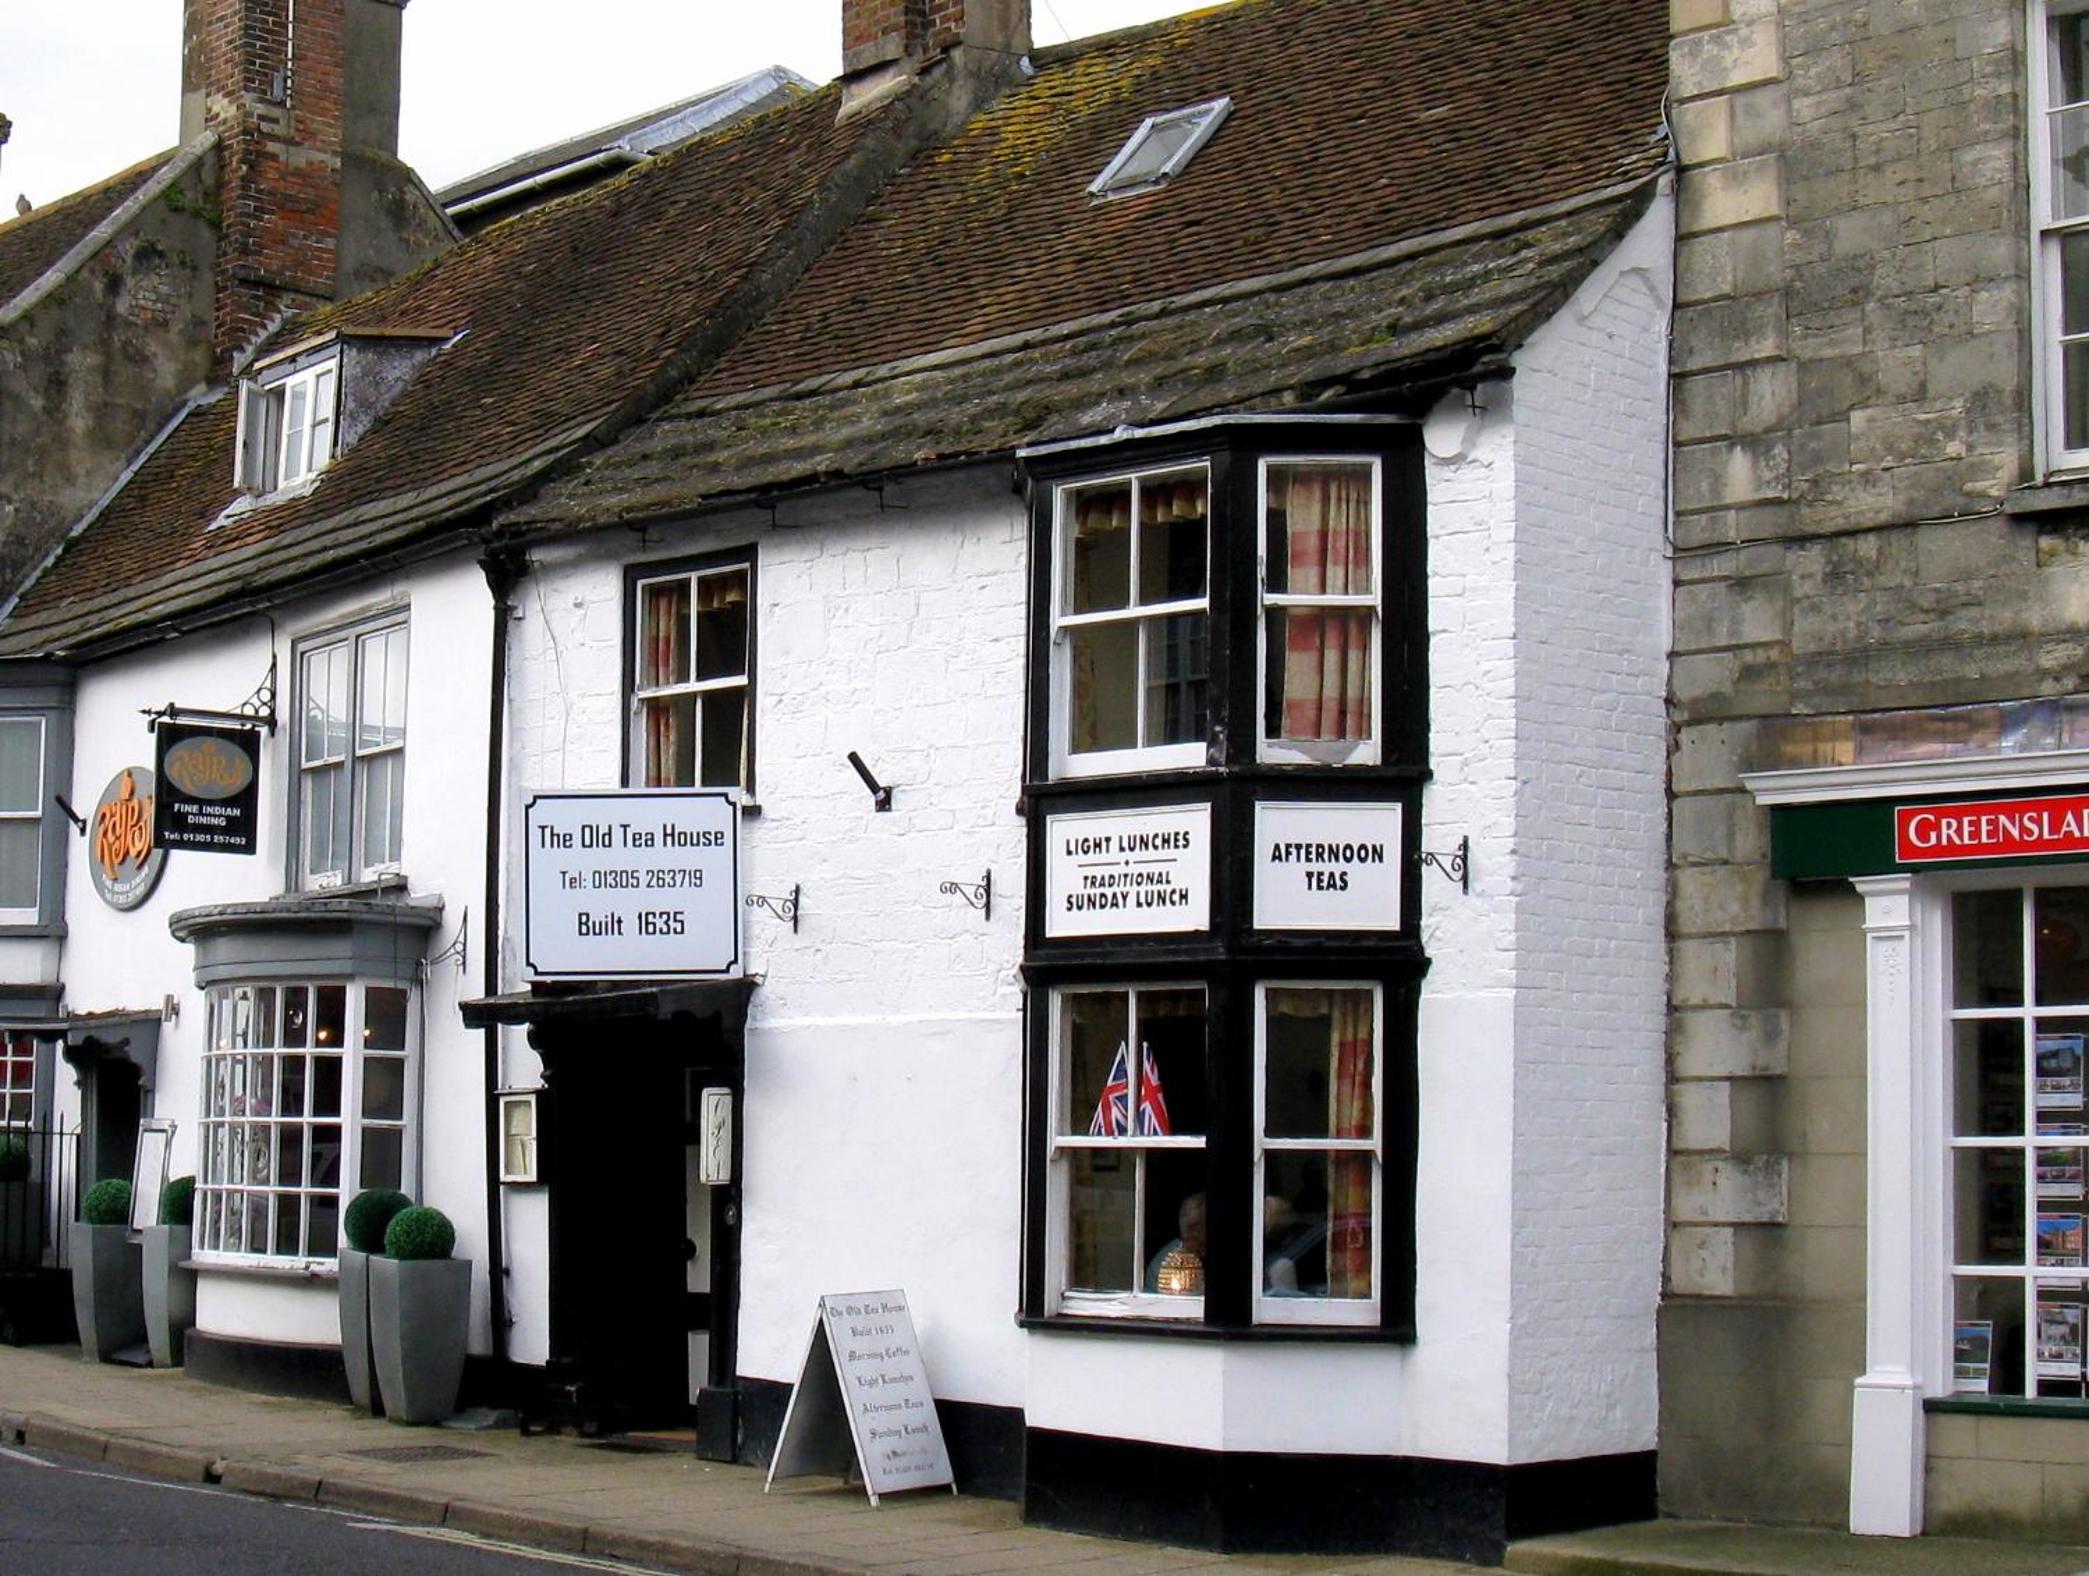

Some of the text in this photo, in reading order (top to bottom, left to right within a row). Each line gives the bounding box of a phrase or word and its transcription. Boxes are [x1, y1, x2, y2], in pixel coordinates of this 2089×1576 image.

[174, 802, 241, 817] FINE INDIAN
[187, 814, 227, 826] DINING
[1908, 809, 2089, 848] GREENSLA
[183, 833, 211, 843] 01305
[538, 823, 725, 849] The Old Tea House
[1065, 830, 1190, 857] LIGHT LUNCHES
[1271, 842, 1385, 864] AFTERNOON
[560, 869, 703, 889] Tel: 01305 263719
[1082, 870, 1172, 890] TRADITIONAL
[1305, 870, 1349, 892] TEAS
[1065, 888, 1189, 912] SUNDAY LUNCH
[577, 911, 685, 936] Built 1635
[863, 1304, 880, 1315] Tea
[850, 1326, 873, 1337] Built
[856, 1376, 880, 1389] Light
